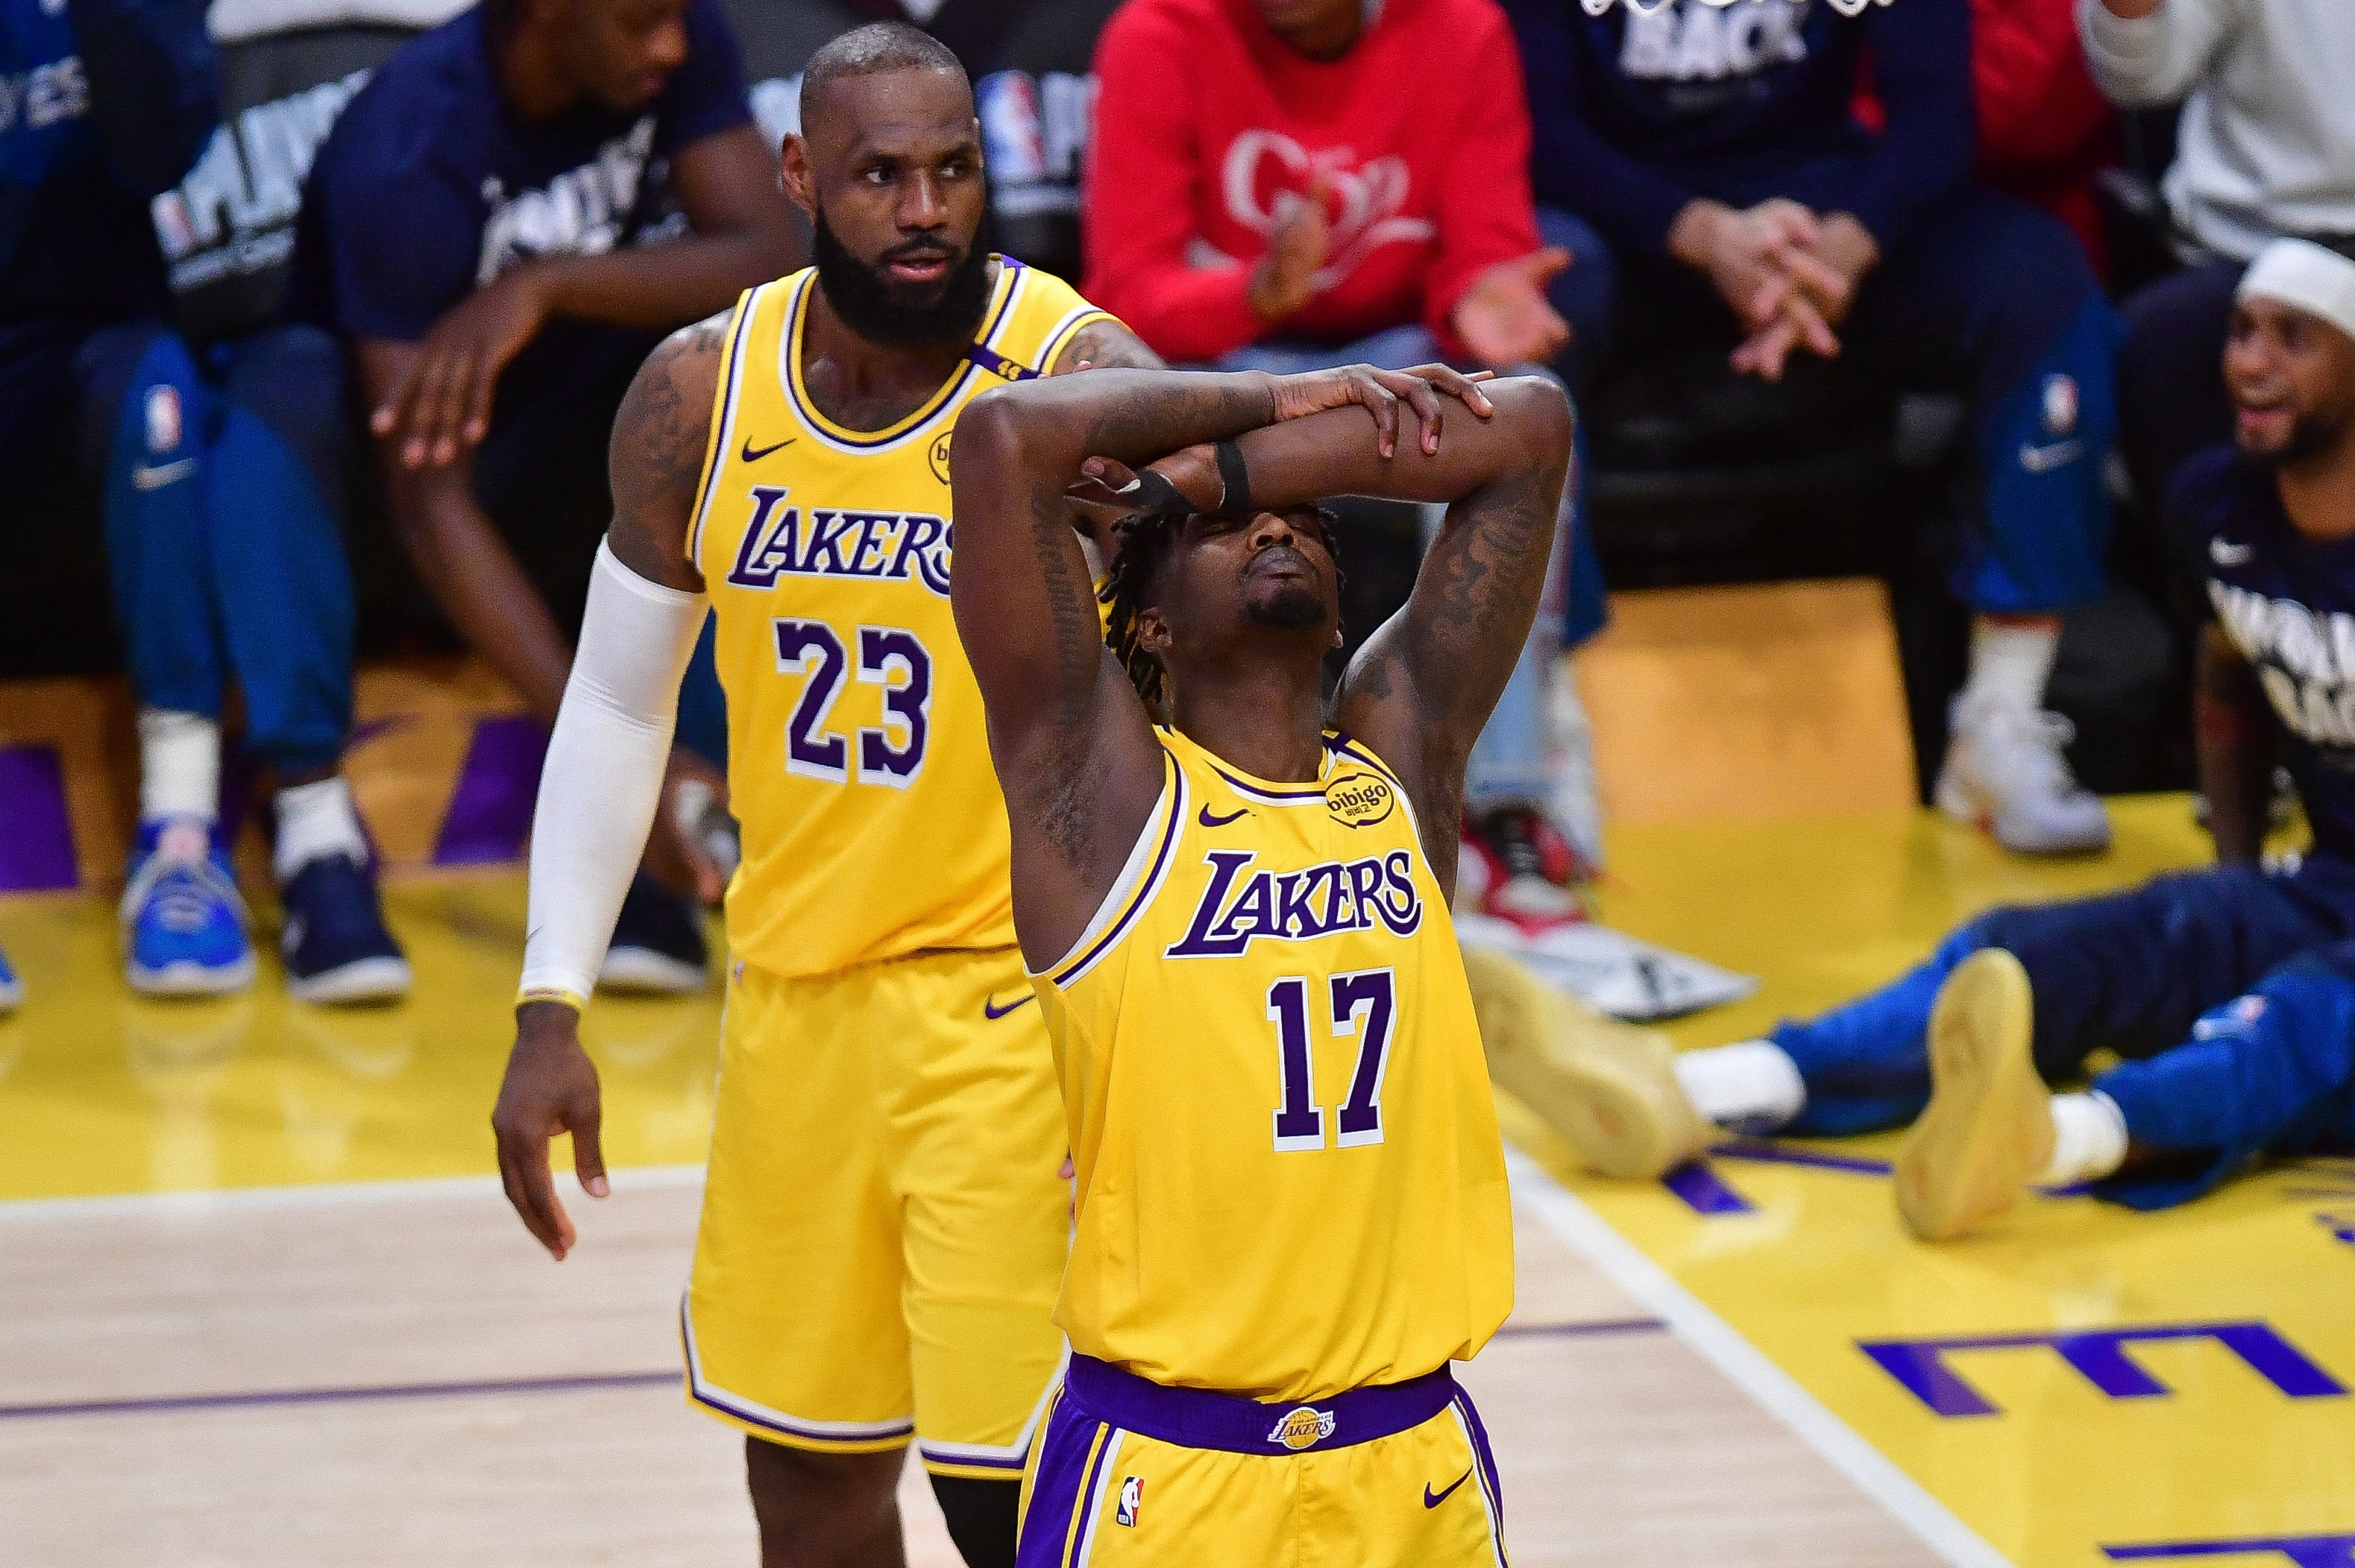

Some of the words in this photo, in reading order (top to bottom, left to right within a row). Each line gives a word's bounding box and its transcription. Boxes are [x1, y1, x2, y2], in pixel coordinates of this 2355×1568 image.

[726, 485, 952, 598] LAKER
[772, 616, 933, 790] 23
[1328, 785, 1387, 812] bibigo
[1162, 848, 1424, 960] LAKERS
[1266, 966, 1397, 1152] 17
[1269, 1419, 1334, 1440] LAKERS
